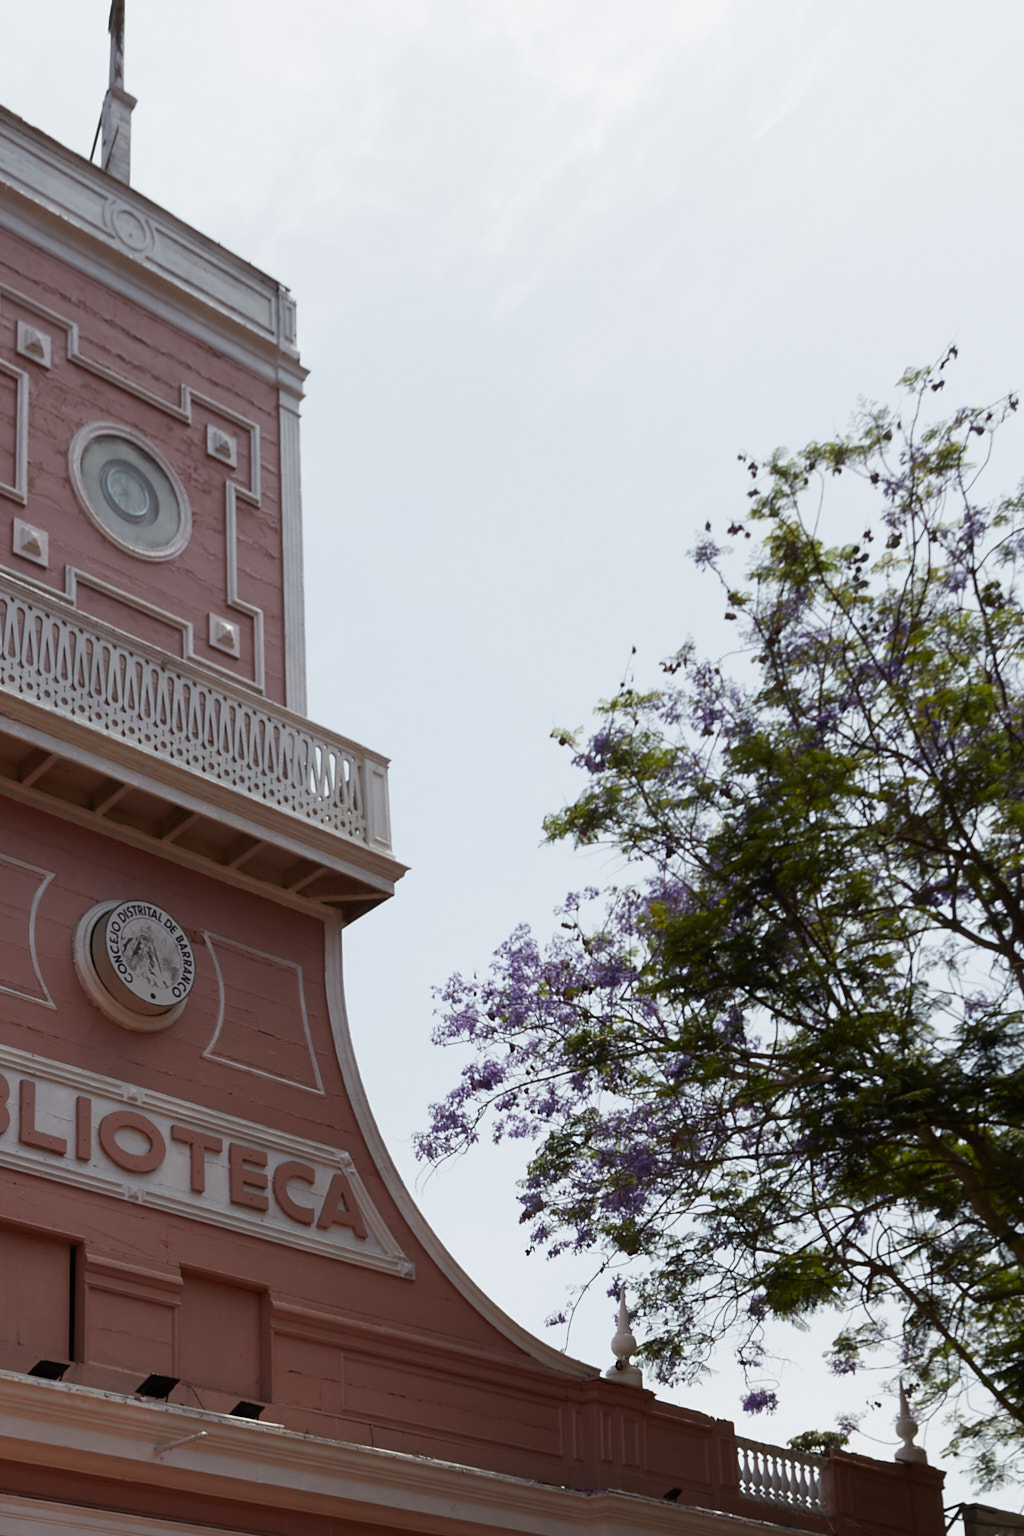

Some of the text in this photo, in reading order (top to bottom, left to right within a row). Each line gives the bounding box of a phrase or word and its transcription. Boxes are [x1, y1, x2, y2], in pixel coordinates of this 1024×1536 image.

[109, 905, 193, 998] CONCEJO DISTRITAL DE BARRANCO
